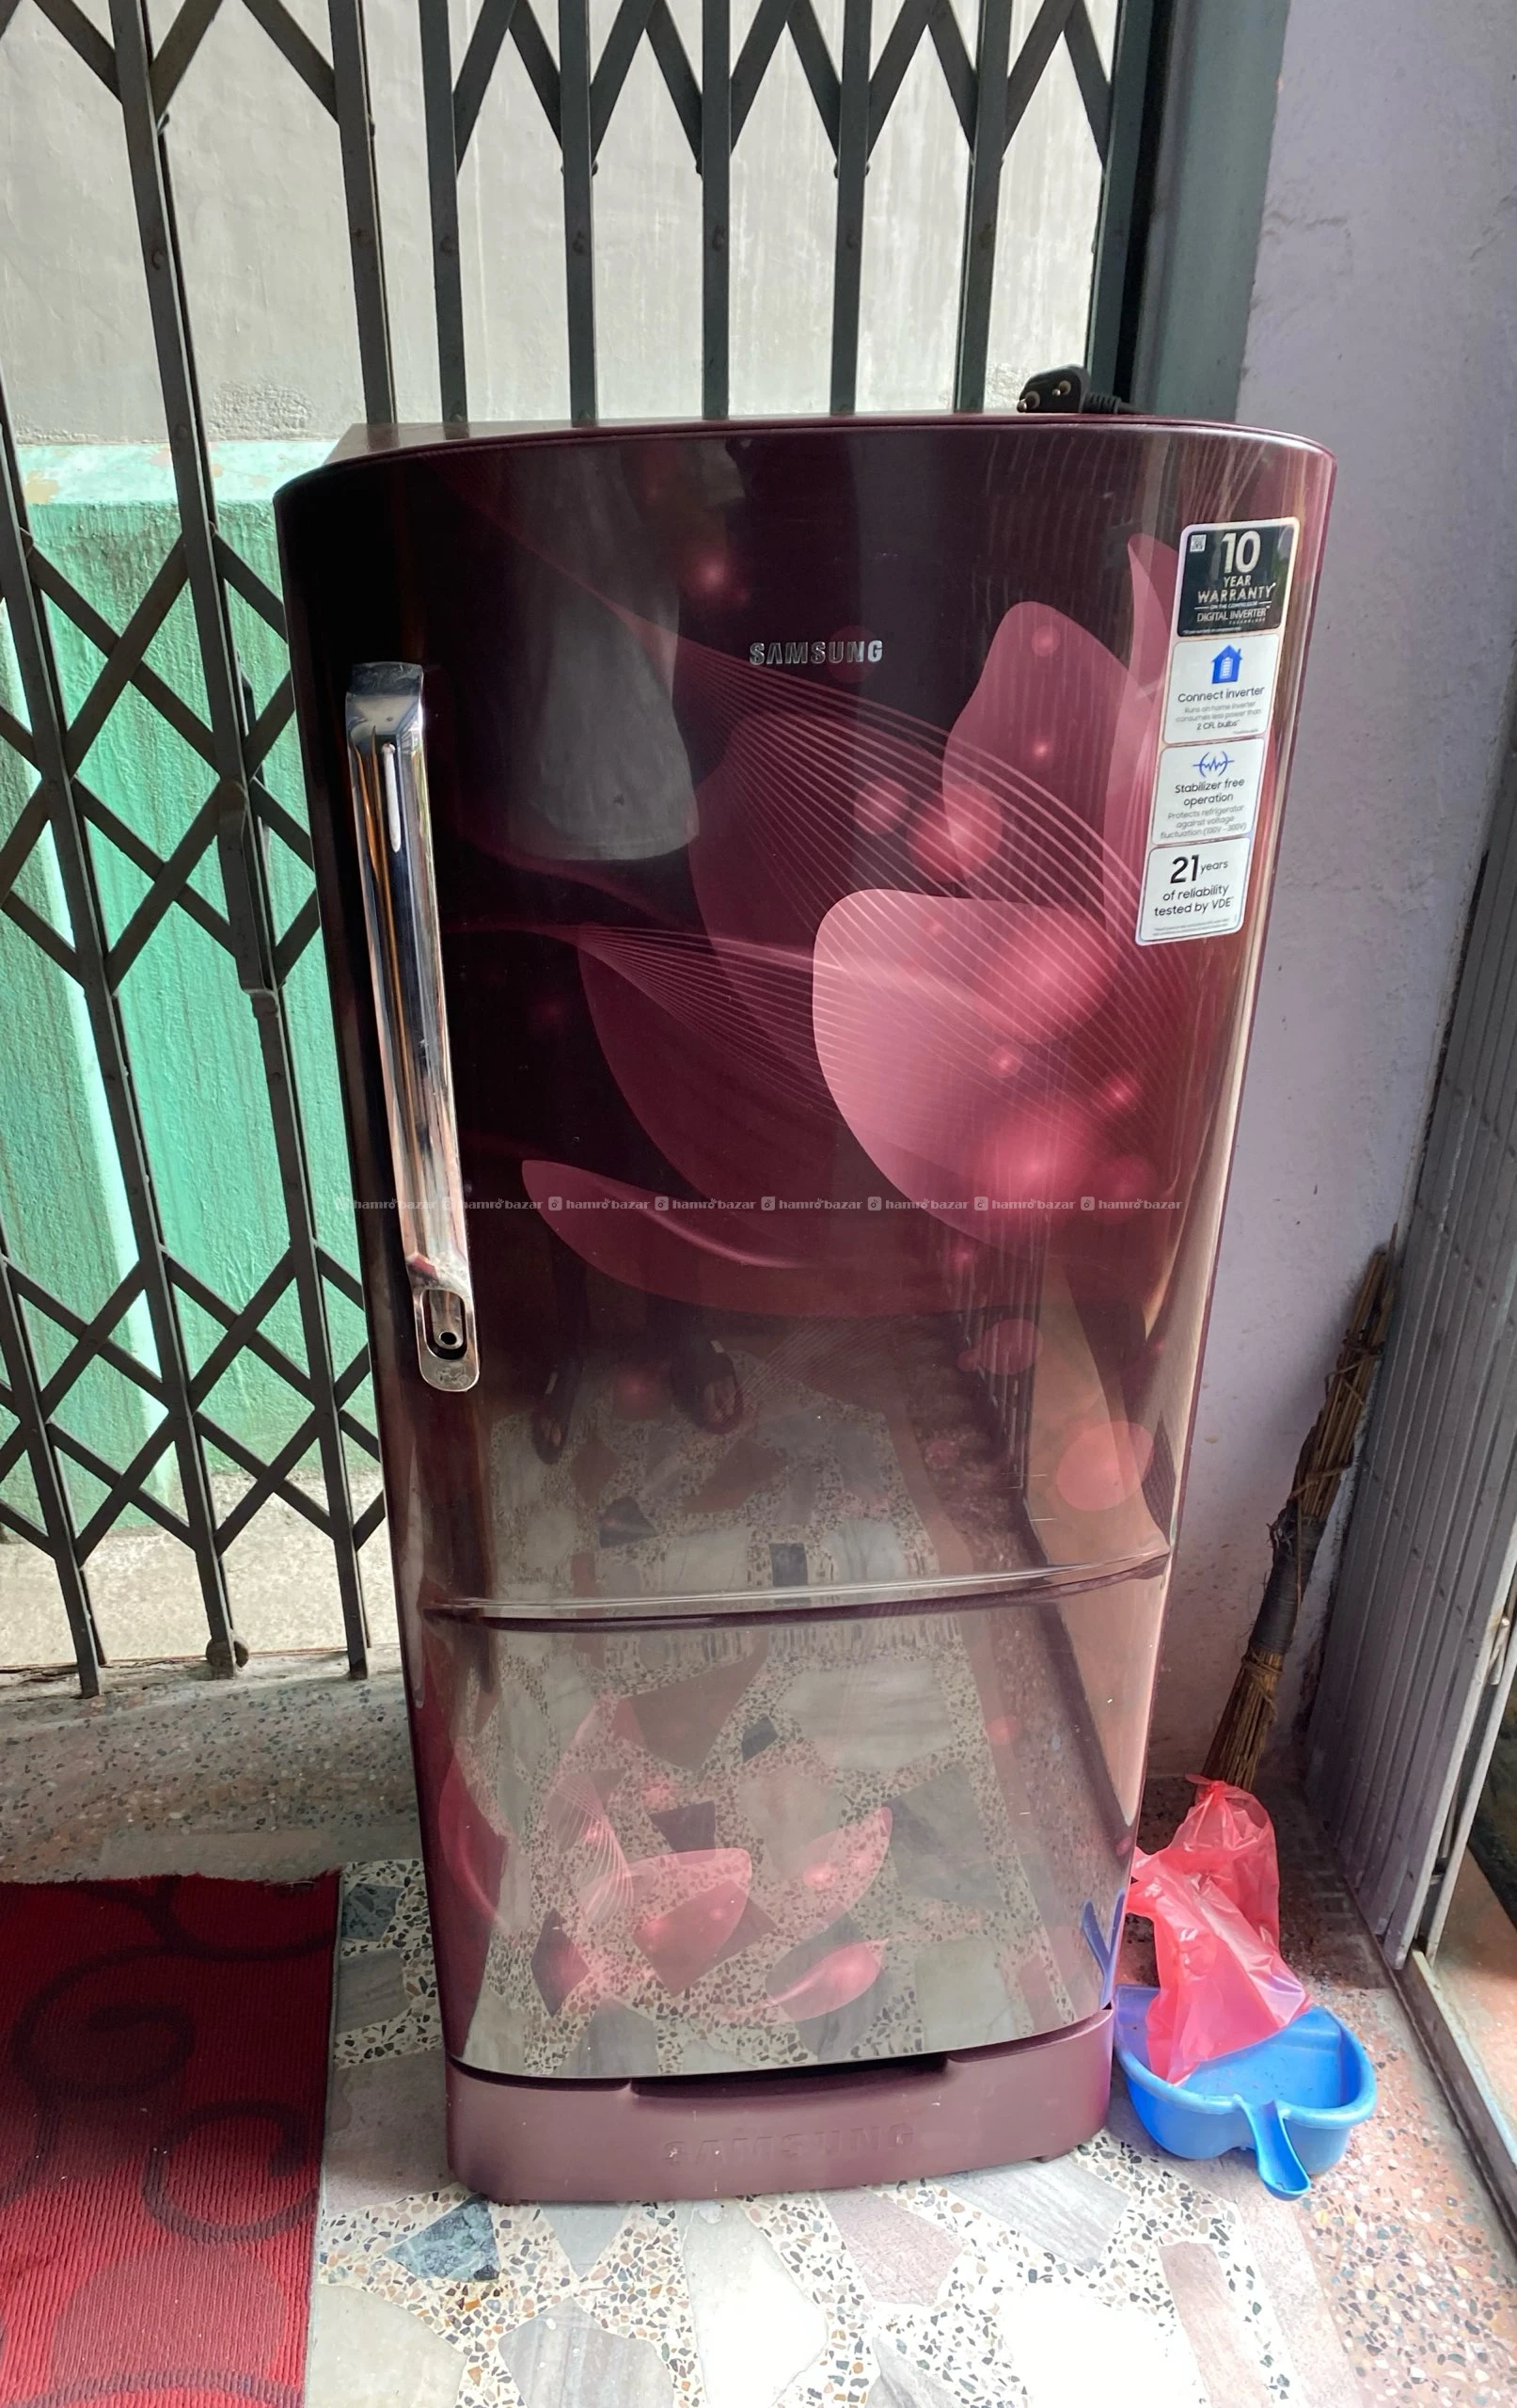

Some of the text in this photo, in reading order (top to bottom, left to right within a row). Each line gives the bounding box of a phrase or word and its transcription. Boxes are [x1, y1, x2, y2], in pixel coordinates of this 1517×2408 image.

[1222, 530, 1260, 574] 10
[1224, 575, 1252, 588] YEAR
[1197, 585, 1272, 603] WARRANTY
[1196, 611, 1228, 623] DIGITAL
[749, 640, 883, 665] SAMSUNG
[1177, 687, 1265, 703] Connect inverter
[1175, 779, 1245, 794] Stabilizer free
[1184, 793, 1233, 808] operation
[1167, 805, 1244, 819] Protects refrigerator
[1177, 816, 1234, 830] against voltage
[1170, 854, 1228, 884] 21 years
[1162, 884, 1229, 901] of reliability
[1154, 903, 1193, 916] tested
[1194, 902, 1209, 914] by
